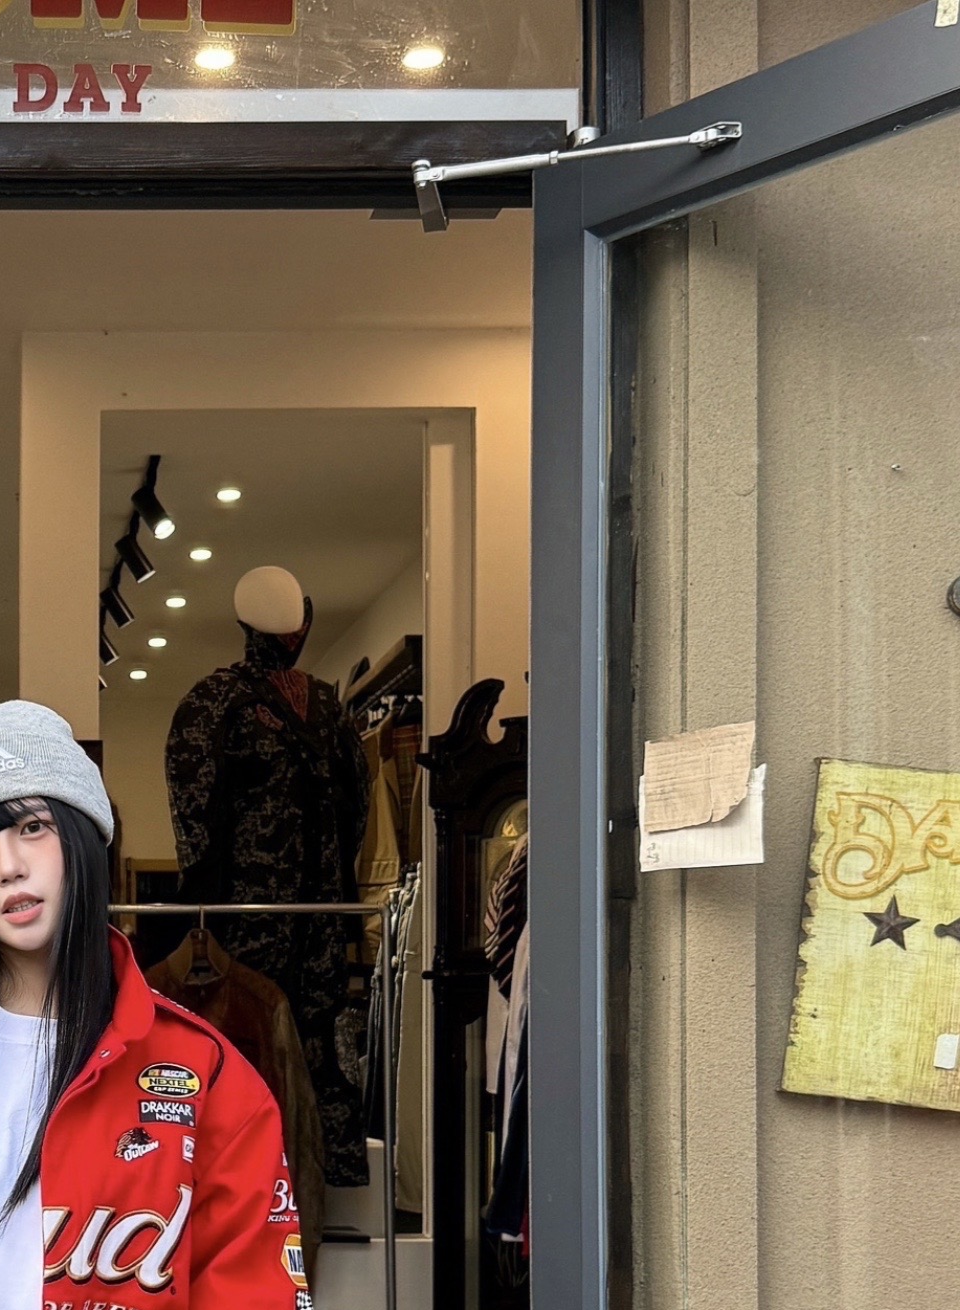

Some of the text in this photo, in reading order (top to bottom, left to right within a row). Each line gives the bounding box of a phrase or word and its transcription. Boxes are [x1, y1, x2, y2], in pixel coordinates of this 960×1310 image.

[13, 64, 152, 114] DAY
[149, 1078, 190, 1088] NEXTEL
[141, 1101, 193, 1117] DRAKKAR
[155, 1113, 181, 1122] NOIR
[123, 1140, 159, 1162] OUTLAW
